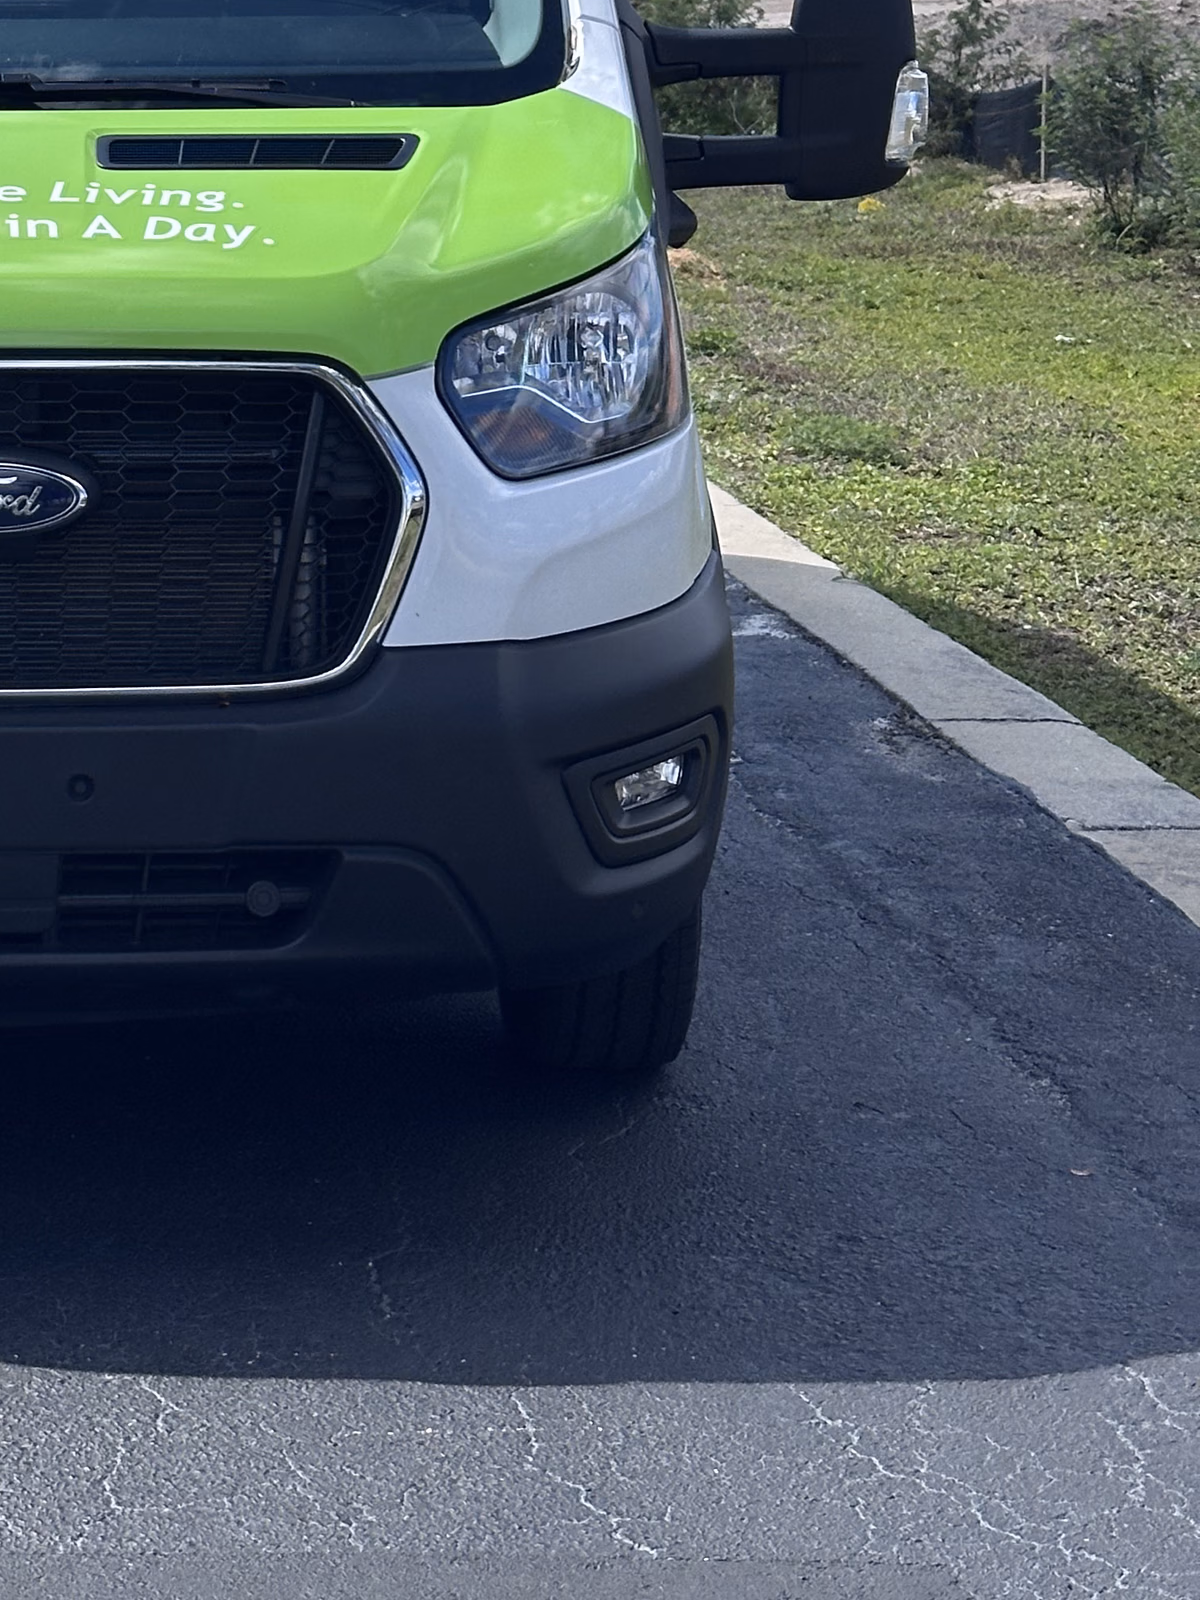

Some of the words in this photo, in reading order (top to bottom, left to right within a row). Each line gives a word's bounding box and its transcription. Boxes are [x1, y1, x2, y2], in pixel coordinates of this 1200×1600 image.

[49, 180, 243, 212] Living.
[4, 213, 58, 238] in
[82, 214, 122, 239] A
[143, 216, 274, 249] Day.
